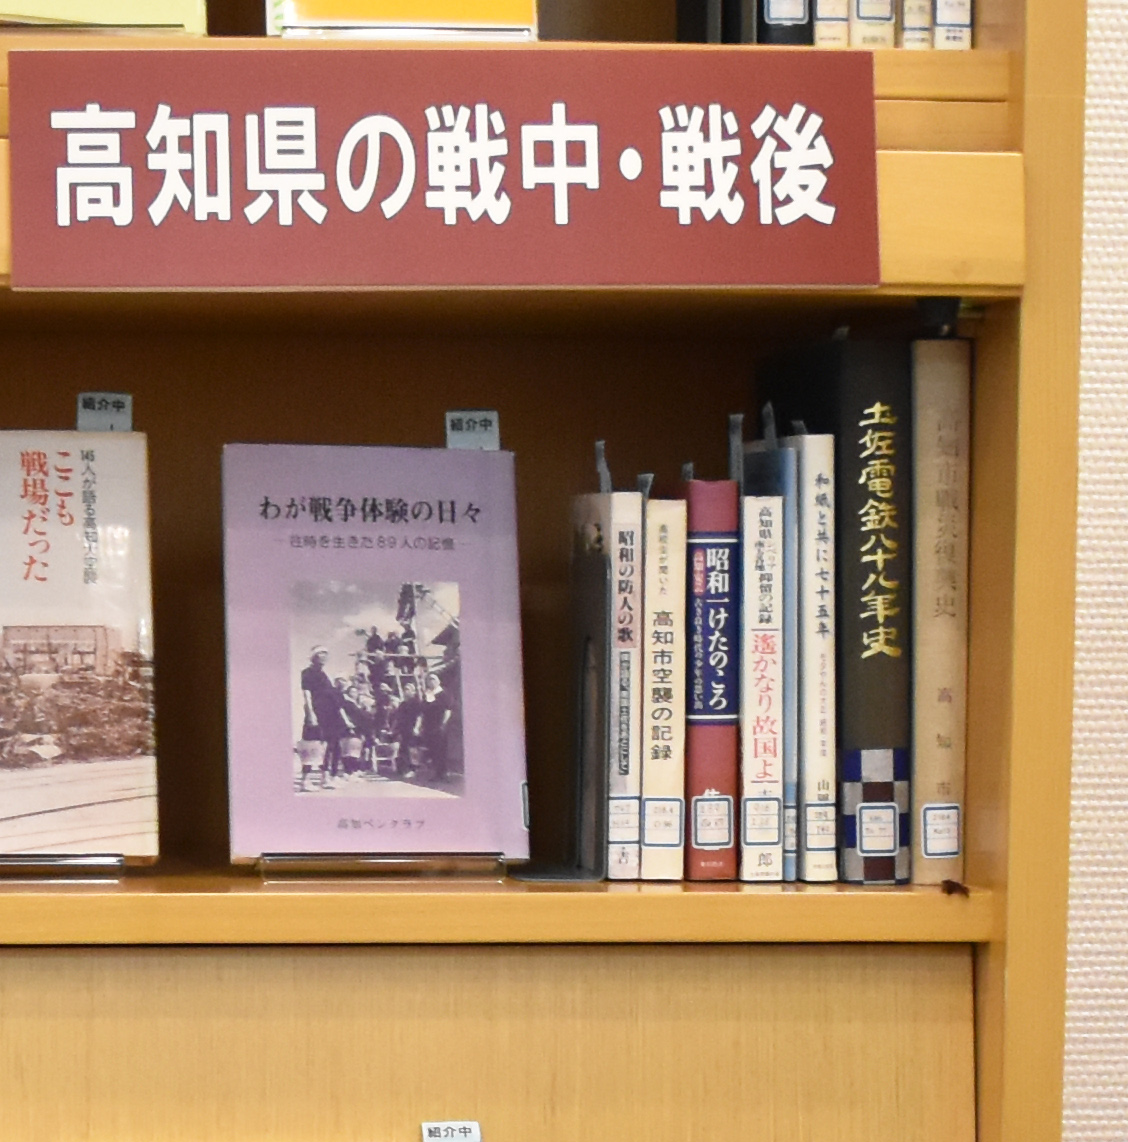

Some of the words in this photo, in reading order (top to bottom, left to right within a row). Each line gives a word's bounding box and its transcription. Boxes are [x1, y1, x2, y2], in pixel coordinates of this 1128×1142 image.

[50, 103, 836, 228] 高知県の戦中・戦後
[82, 397, 126, 413] 紹介中
[450, 417, 494, 432] 紹介中
[20, 450, 50, 584] 戦場だった
[54, 450, 75, 527] ここも
[258, 496, 482, 525] わが戦争体験の日々
[857, 401, 902, 660] 土佐電鉄八十八年史
[617, 530, 635, 643] 昭和の防人の歌
[706, 547, 730, 710] 昭和一けたのころ
[651, 610, 674, 761] 高知市空襲の記録
[427, 1125, 472, 1139] 紹介中
